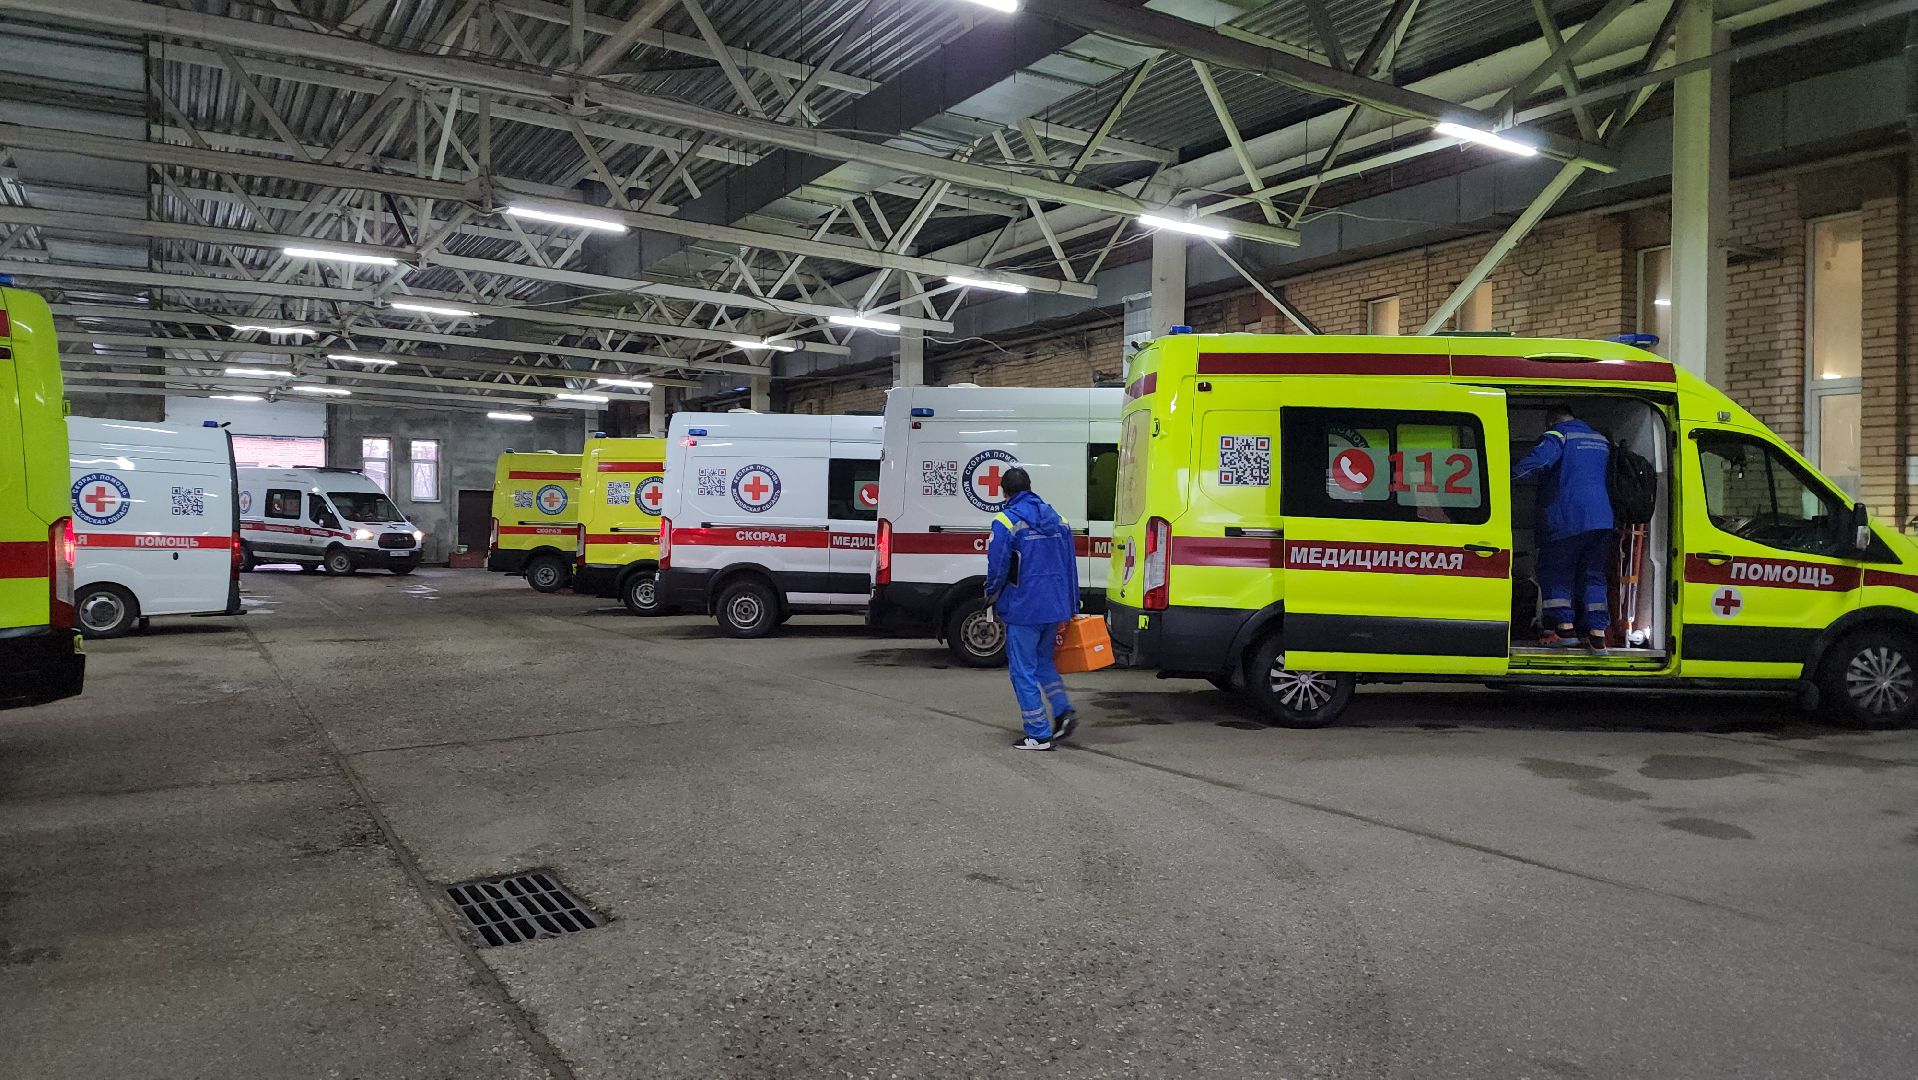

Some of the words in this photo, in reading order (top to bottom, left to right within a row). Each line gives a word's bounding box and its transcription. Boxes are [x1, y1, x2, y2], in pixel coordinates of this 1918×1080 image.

[965, 451, 991, 475] СКОРАЯ
[994, 451, 1017, 466] ПОМО
[1388, 451, 1473, 494] 112
[72, 474, 97, 494] СКОРАЯ
[100, 474, 128, 496] ПОМОЩЬ
[734, 465, 754, 483] СКОРАЯ
[757, 465, 779, 484] ПОМОЩЬ
[761, 489, 781, 511] ОБЛАСТЬ
[963, 480, 1000, 511] МОСКОВСКАЯ
[135, 536, 199, 549] ПОМОЩЬ
[735, 530, 786, 543] СКОРАЯ
[1290, 546, 1464, 570] МЕДИЦИНСКАЯ
[1730, 562, 1835, 587] ПОМОЩЬ
